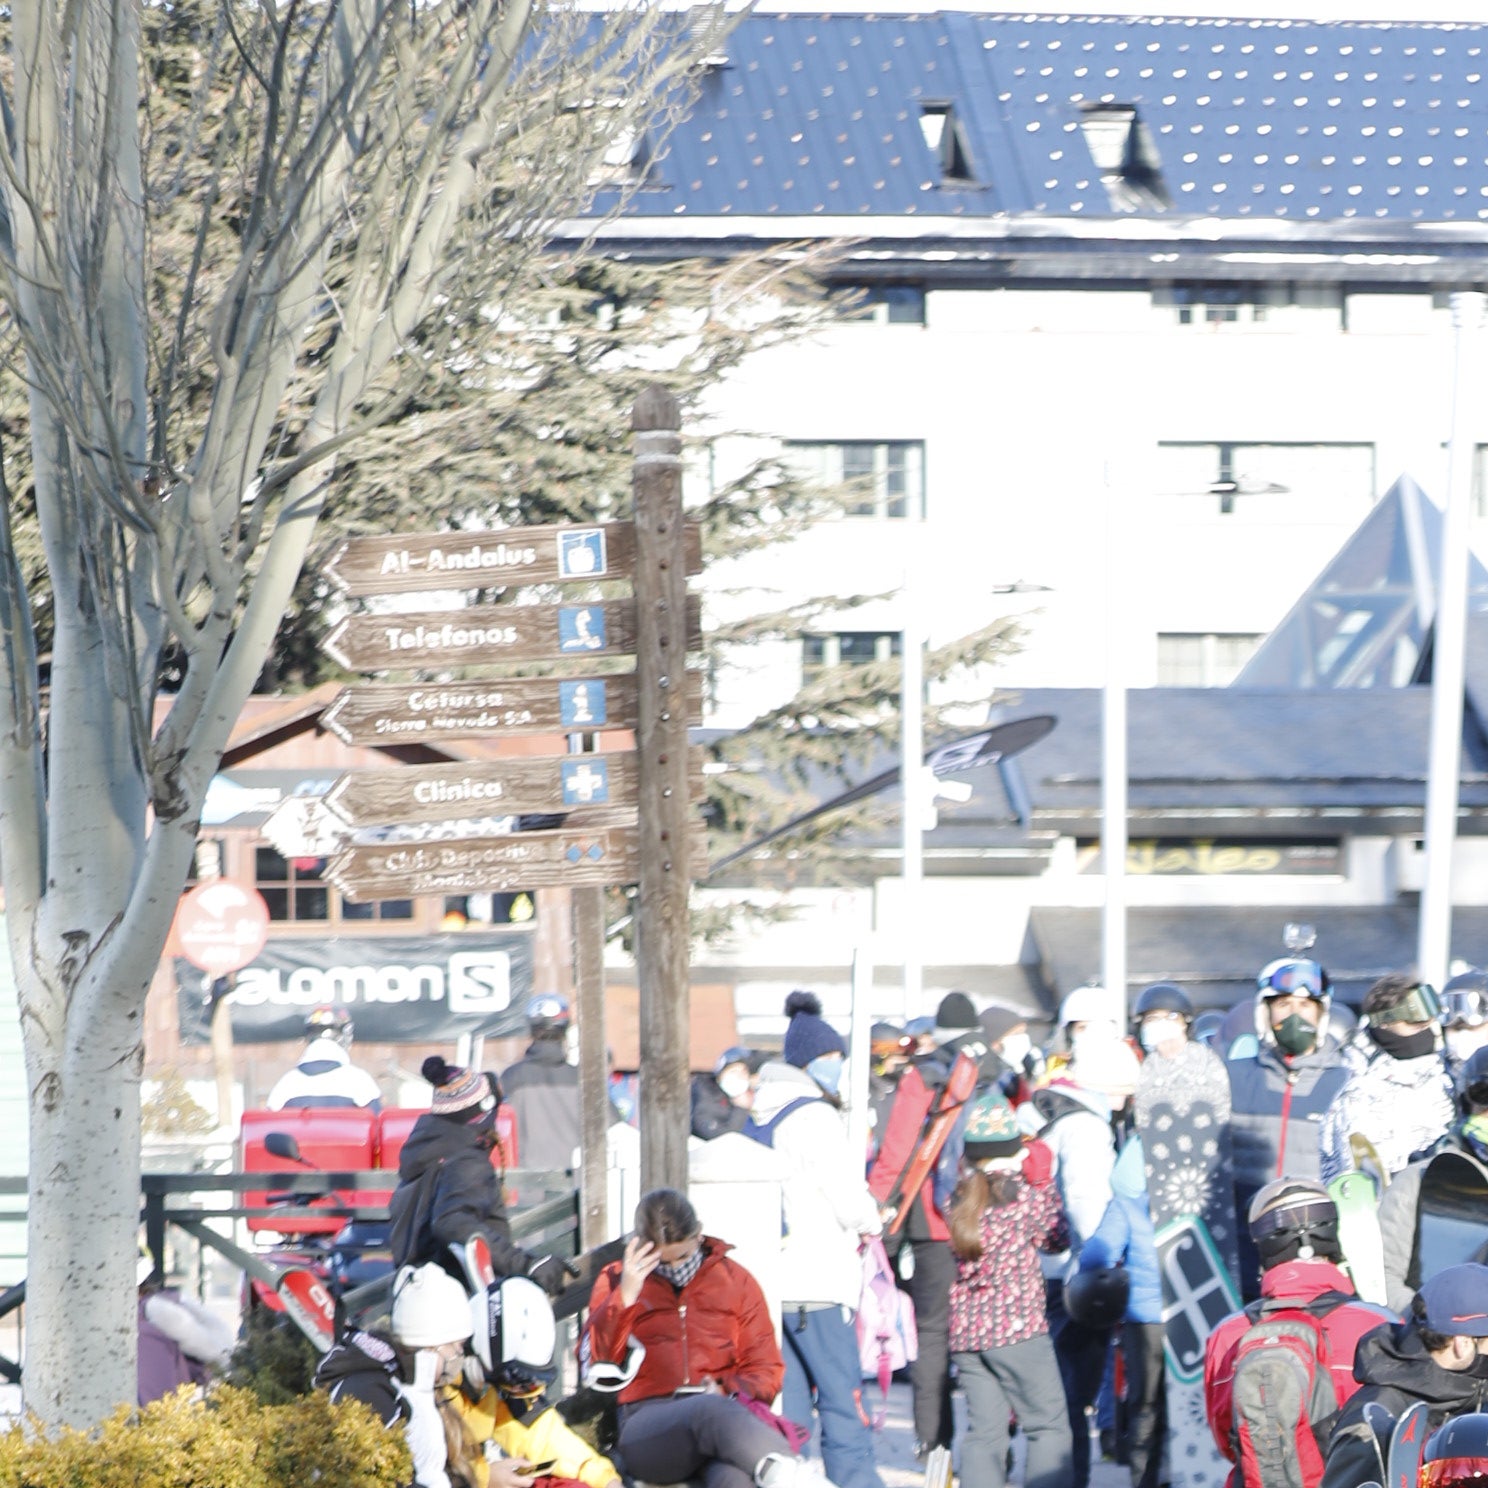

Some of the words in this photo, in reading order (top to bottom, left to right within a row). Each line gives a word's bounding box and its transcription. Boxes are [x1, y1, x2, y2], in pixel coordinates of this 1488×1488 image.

[379, 544, 537, 575] Al-Andalus
[408, 691, 503, 712] Cetursa
[413, 777, 503, 804] Clinica
[205, 964, 446, 1005] alomon
